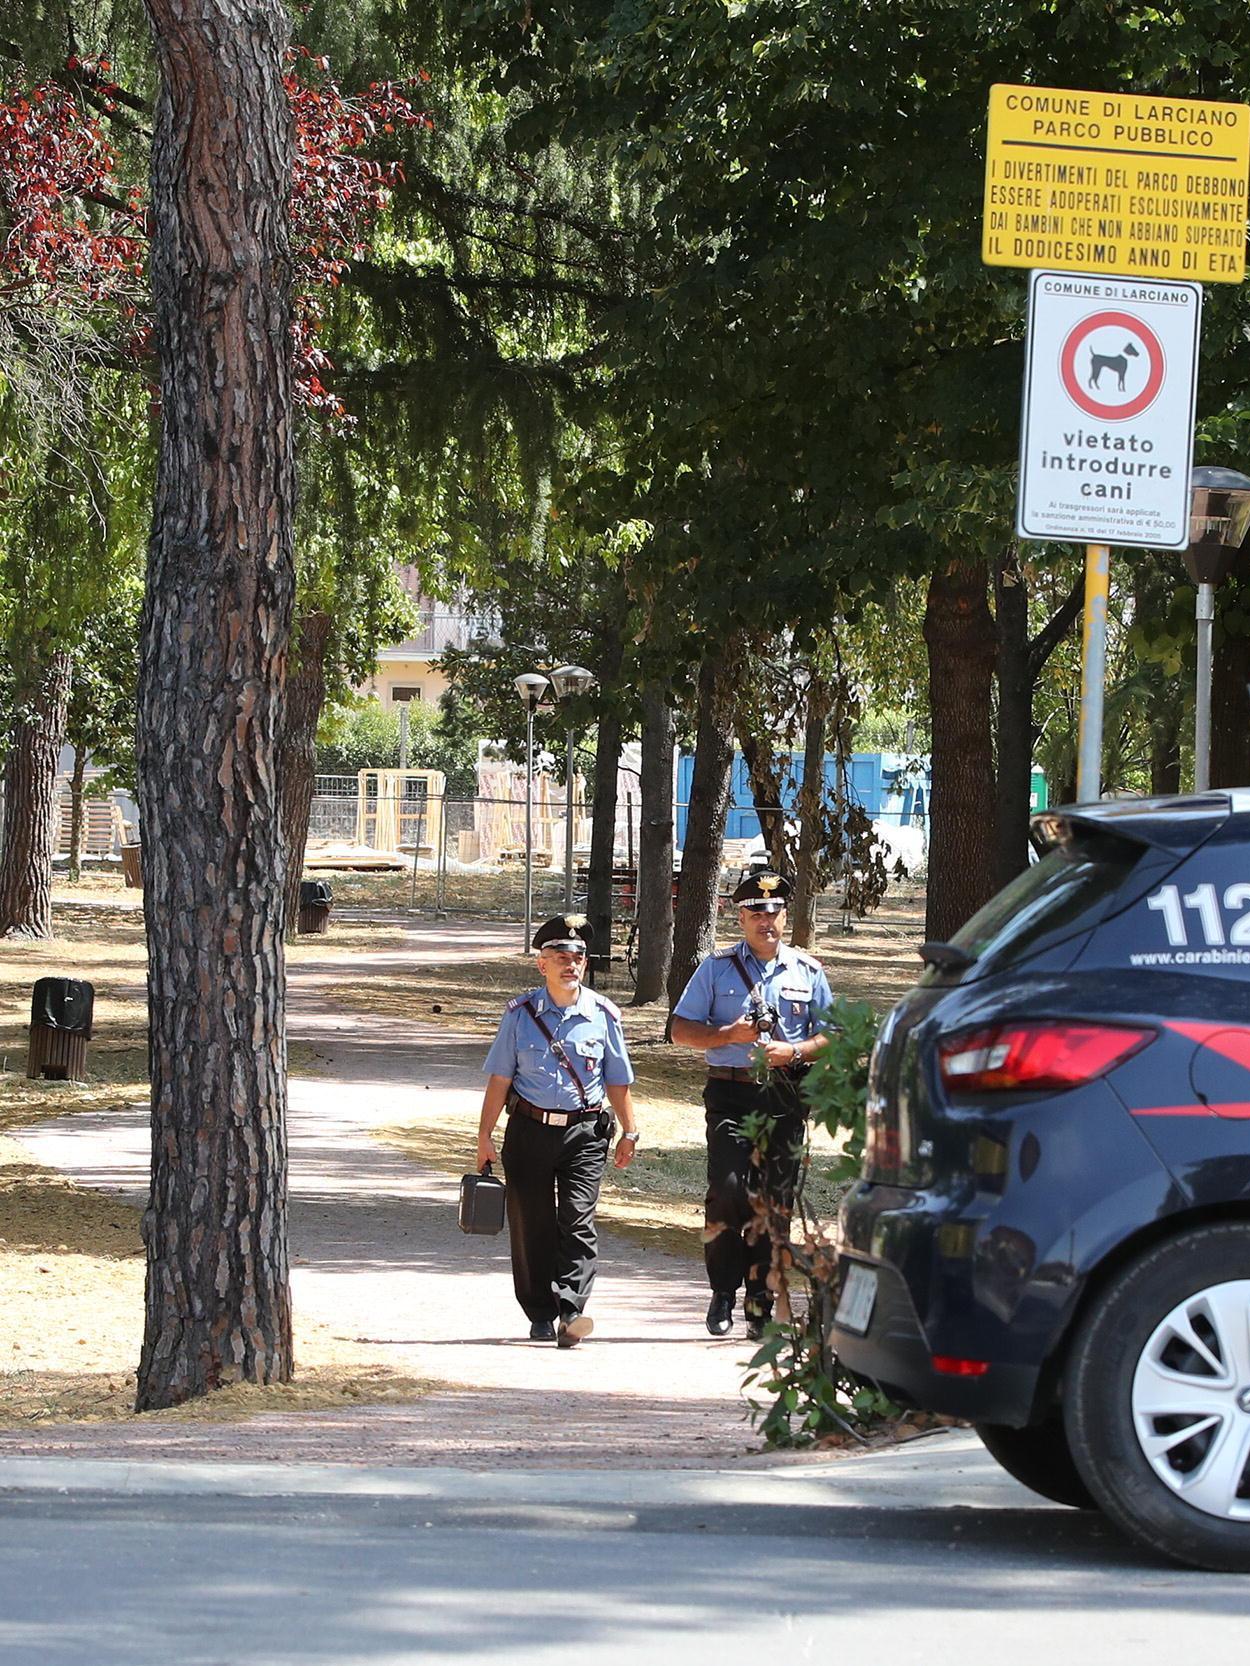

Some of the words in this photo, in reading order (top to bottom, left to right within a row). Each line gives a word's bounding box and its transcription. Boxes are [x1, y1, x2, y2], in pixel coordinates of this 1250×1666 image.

[1006, 94, 1090, 116] COMUNE
[1103, 102, 1121, 118] DI
[1134, 104, 1238, 127] LARCIANO
[1033, 120, 1101, 139] PARCO
[1113, 125, 1214, 147] PUBBLICO
[991, 160, 997, 178] I
[1004, 160, 1098, 186] DIVERTIMENTI
[1105, 169, 1128, 189] DEL
[1137, 171, 1178, 192] PARCO
[1186, 175, 1246, 197] DEBBONO
[990, 185, 1042, 207] ESSERE
[1050, 190, 1121, 214] ADOPERATI
[1129, 196, 1243, 223] ESCLUSIVAMENTE
[990, 211, 1008, 231] DAI
[1015, 213, 1064, 235] BAMBINI
[1071, 216, 1093, 237] CHE
[1098, 218, 1122, 239] NON
[1129, 220, 1178, 244] ABBIANO
[1185, 225, 1243, 248] SUPERATO
[988, 236, 1003, 255] IL
[1014, 238, 1117, 264] DODICESIMO
[1128, 247, 1170, 268] ANNO
[1182, 251, 1197, 270] DI
[1044, 281, 1100, 296] COMUNE
[1105, 287, 1118, 297] DI
[1122, 288, 1189, 304] LARCIANO
[1064, 430, 1154, 453] vietato
[1041, 452, 1171, 478] introdurre
[1080, 482, 1132, 500] cani
[1041, 512, 1076, 520] sanzione
[1058, 502, 1105, 513] trasgressori
[1125, 508, 1161, 517] applicata
